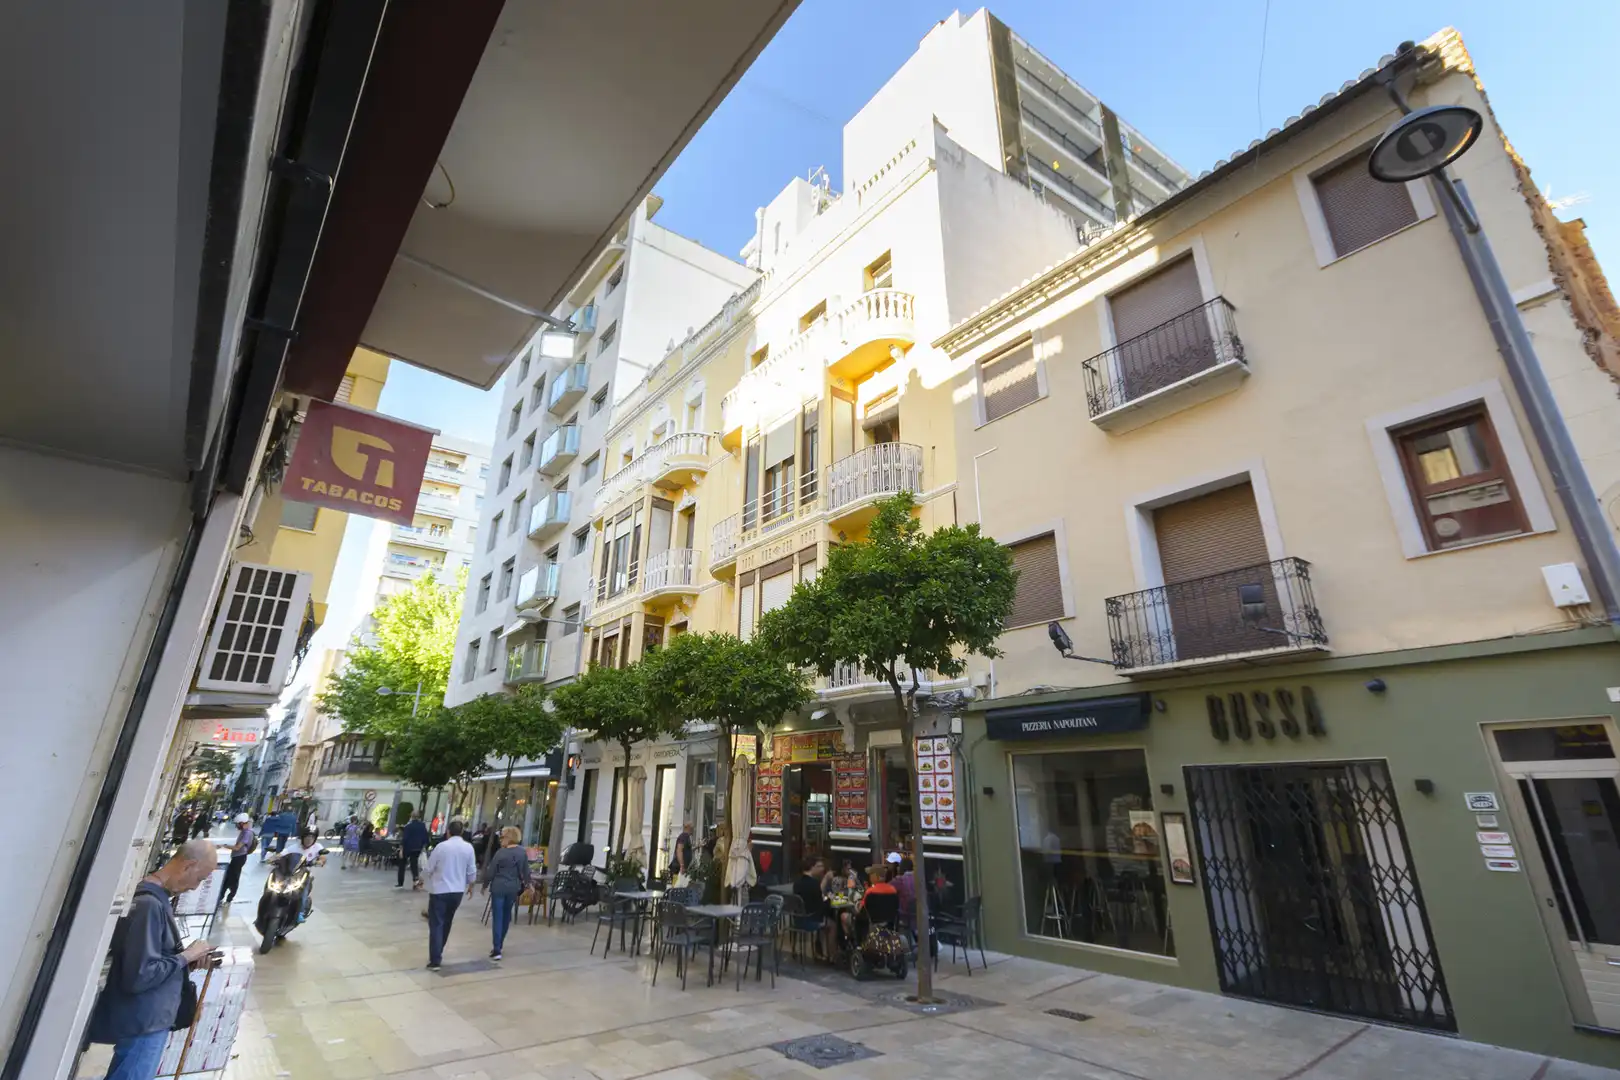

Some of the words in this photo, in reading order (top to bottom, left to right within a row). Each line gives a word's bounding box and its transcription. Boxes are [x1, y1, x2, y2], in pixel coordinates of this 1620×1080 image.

[301, 477, 403, 511] TABACOS
[1022, 720, 1051, 732] PIZZERIA
[1054, 717, 1098, 730] NAPOLITANA
[1206, 686, 1326, 742] BUSSA
